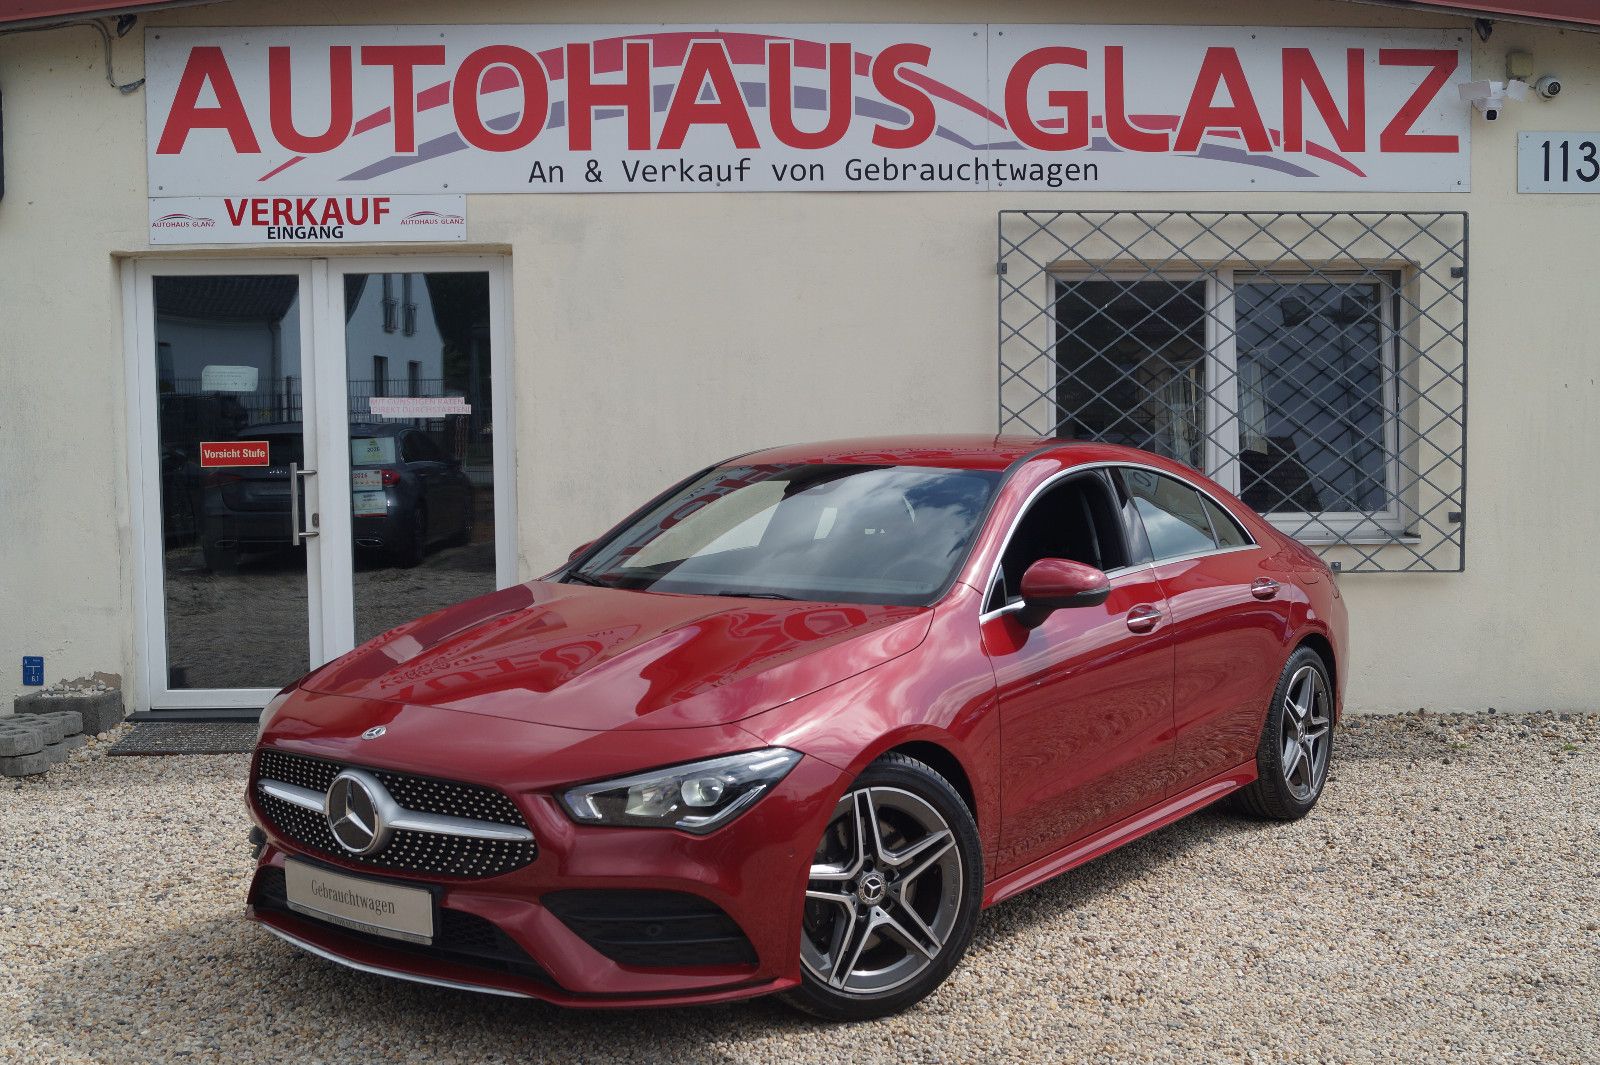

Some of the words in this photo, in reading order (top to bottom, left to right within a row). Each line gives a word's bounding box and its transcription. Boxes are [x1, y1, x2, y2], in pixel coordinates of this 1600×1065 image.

[157, 43, 936, 154] AUTOHAUS
[1004, 46, 1460, 154] GLANZ
[528, 160, 564, 183] An
[584, 160, 603, 183] &
[621, 157, 751, 183] Verkauf
[771, 163, 824, 182] von
[845, 156, 1098, 188] Gebrauchtwagen
[1541, 140, 1600, 183] 113
[223, 197, 391, 226] VERKAUF
[267, 225, 344, 240] EINGANG
[204, 449, 241, 459] Vorsicht
[242, 448, 266, 458] Stufe
[311, 879, 396, 916] Gebrauchtwagen
